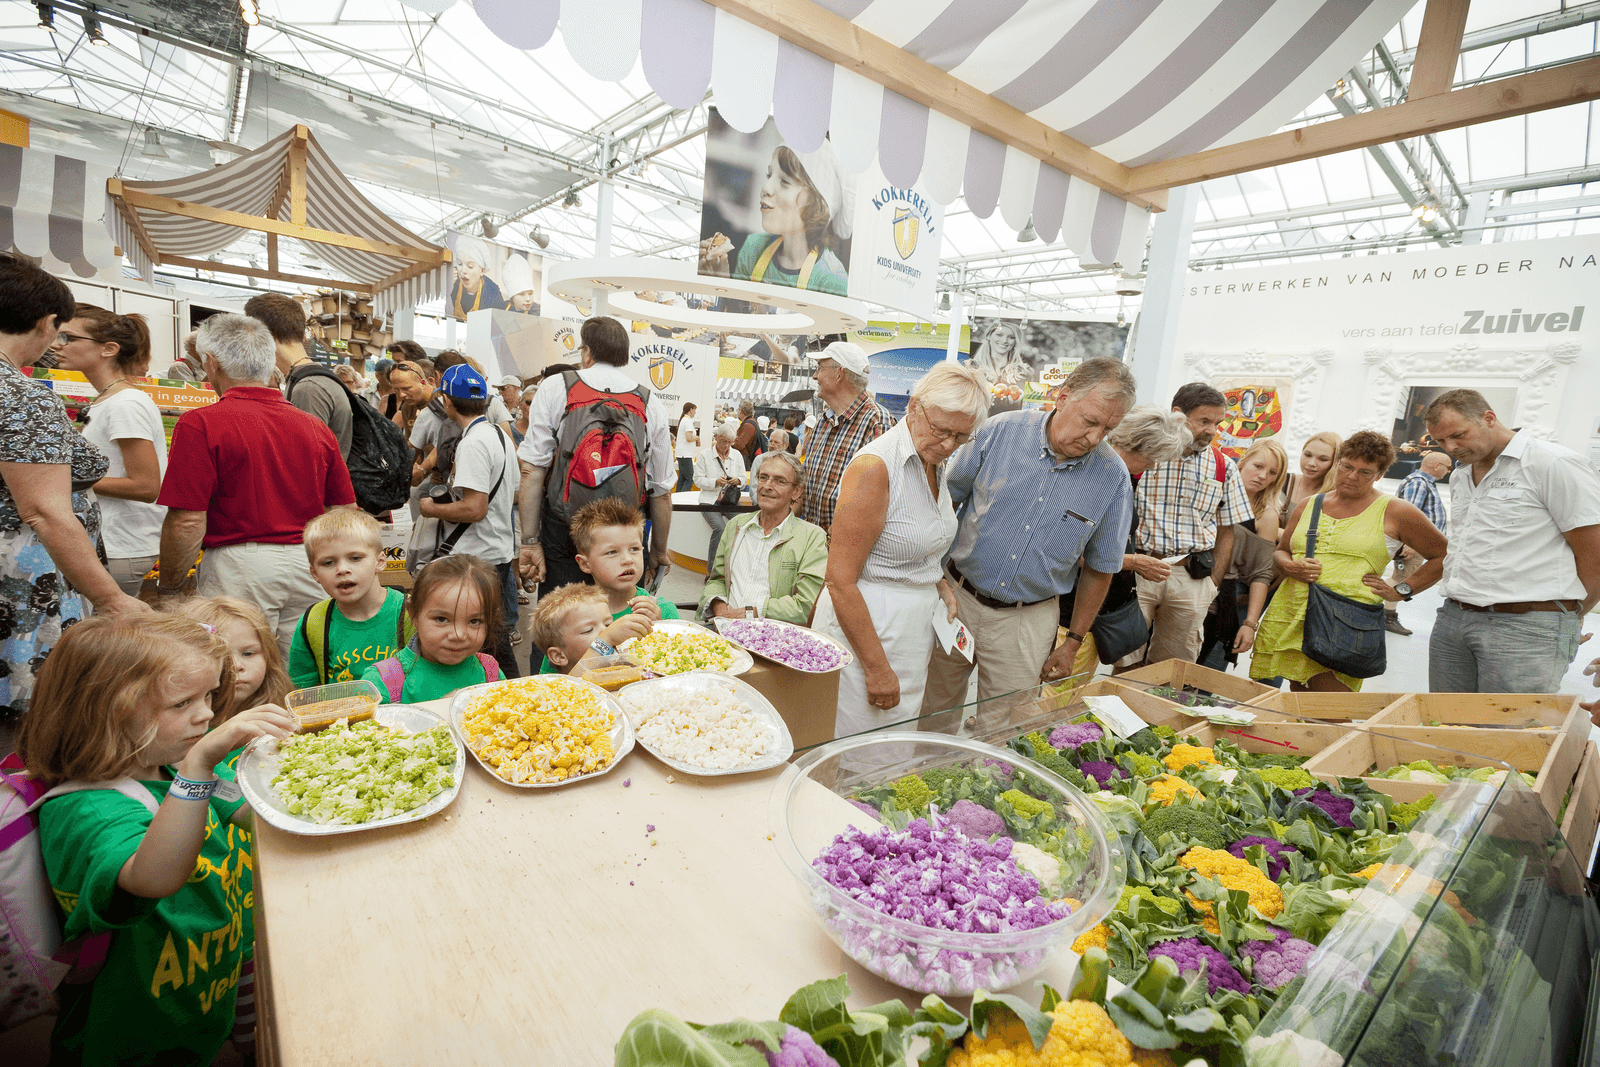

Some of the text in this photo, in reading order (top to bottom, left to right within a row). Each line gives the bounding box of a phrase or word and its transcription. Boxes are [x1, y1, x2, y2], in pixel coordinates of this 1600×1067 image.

[872, 186, 935, 234] KOKKERELLI
[877, 255, 922, 279] KIDS UNIVERSITY
[1182, 254, 1597, 297] STERWERKEN VAN MOEDER NA
[1341, 305, 1586, 338] vers aan tafel Zuivel
[631, 344, 693, 370] KOKKERELLI
[157, 390, 170, 400] in
[173, 393, 220, 404] gezond
